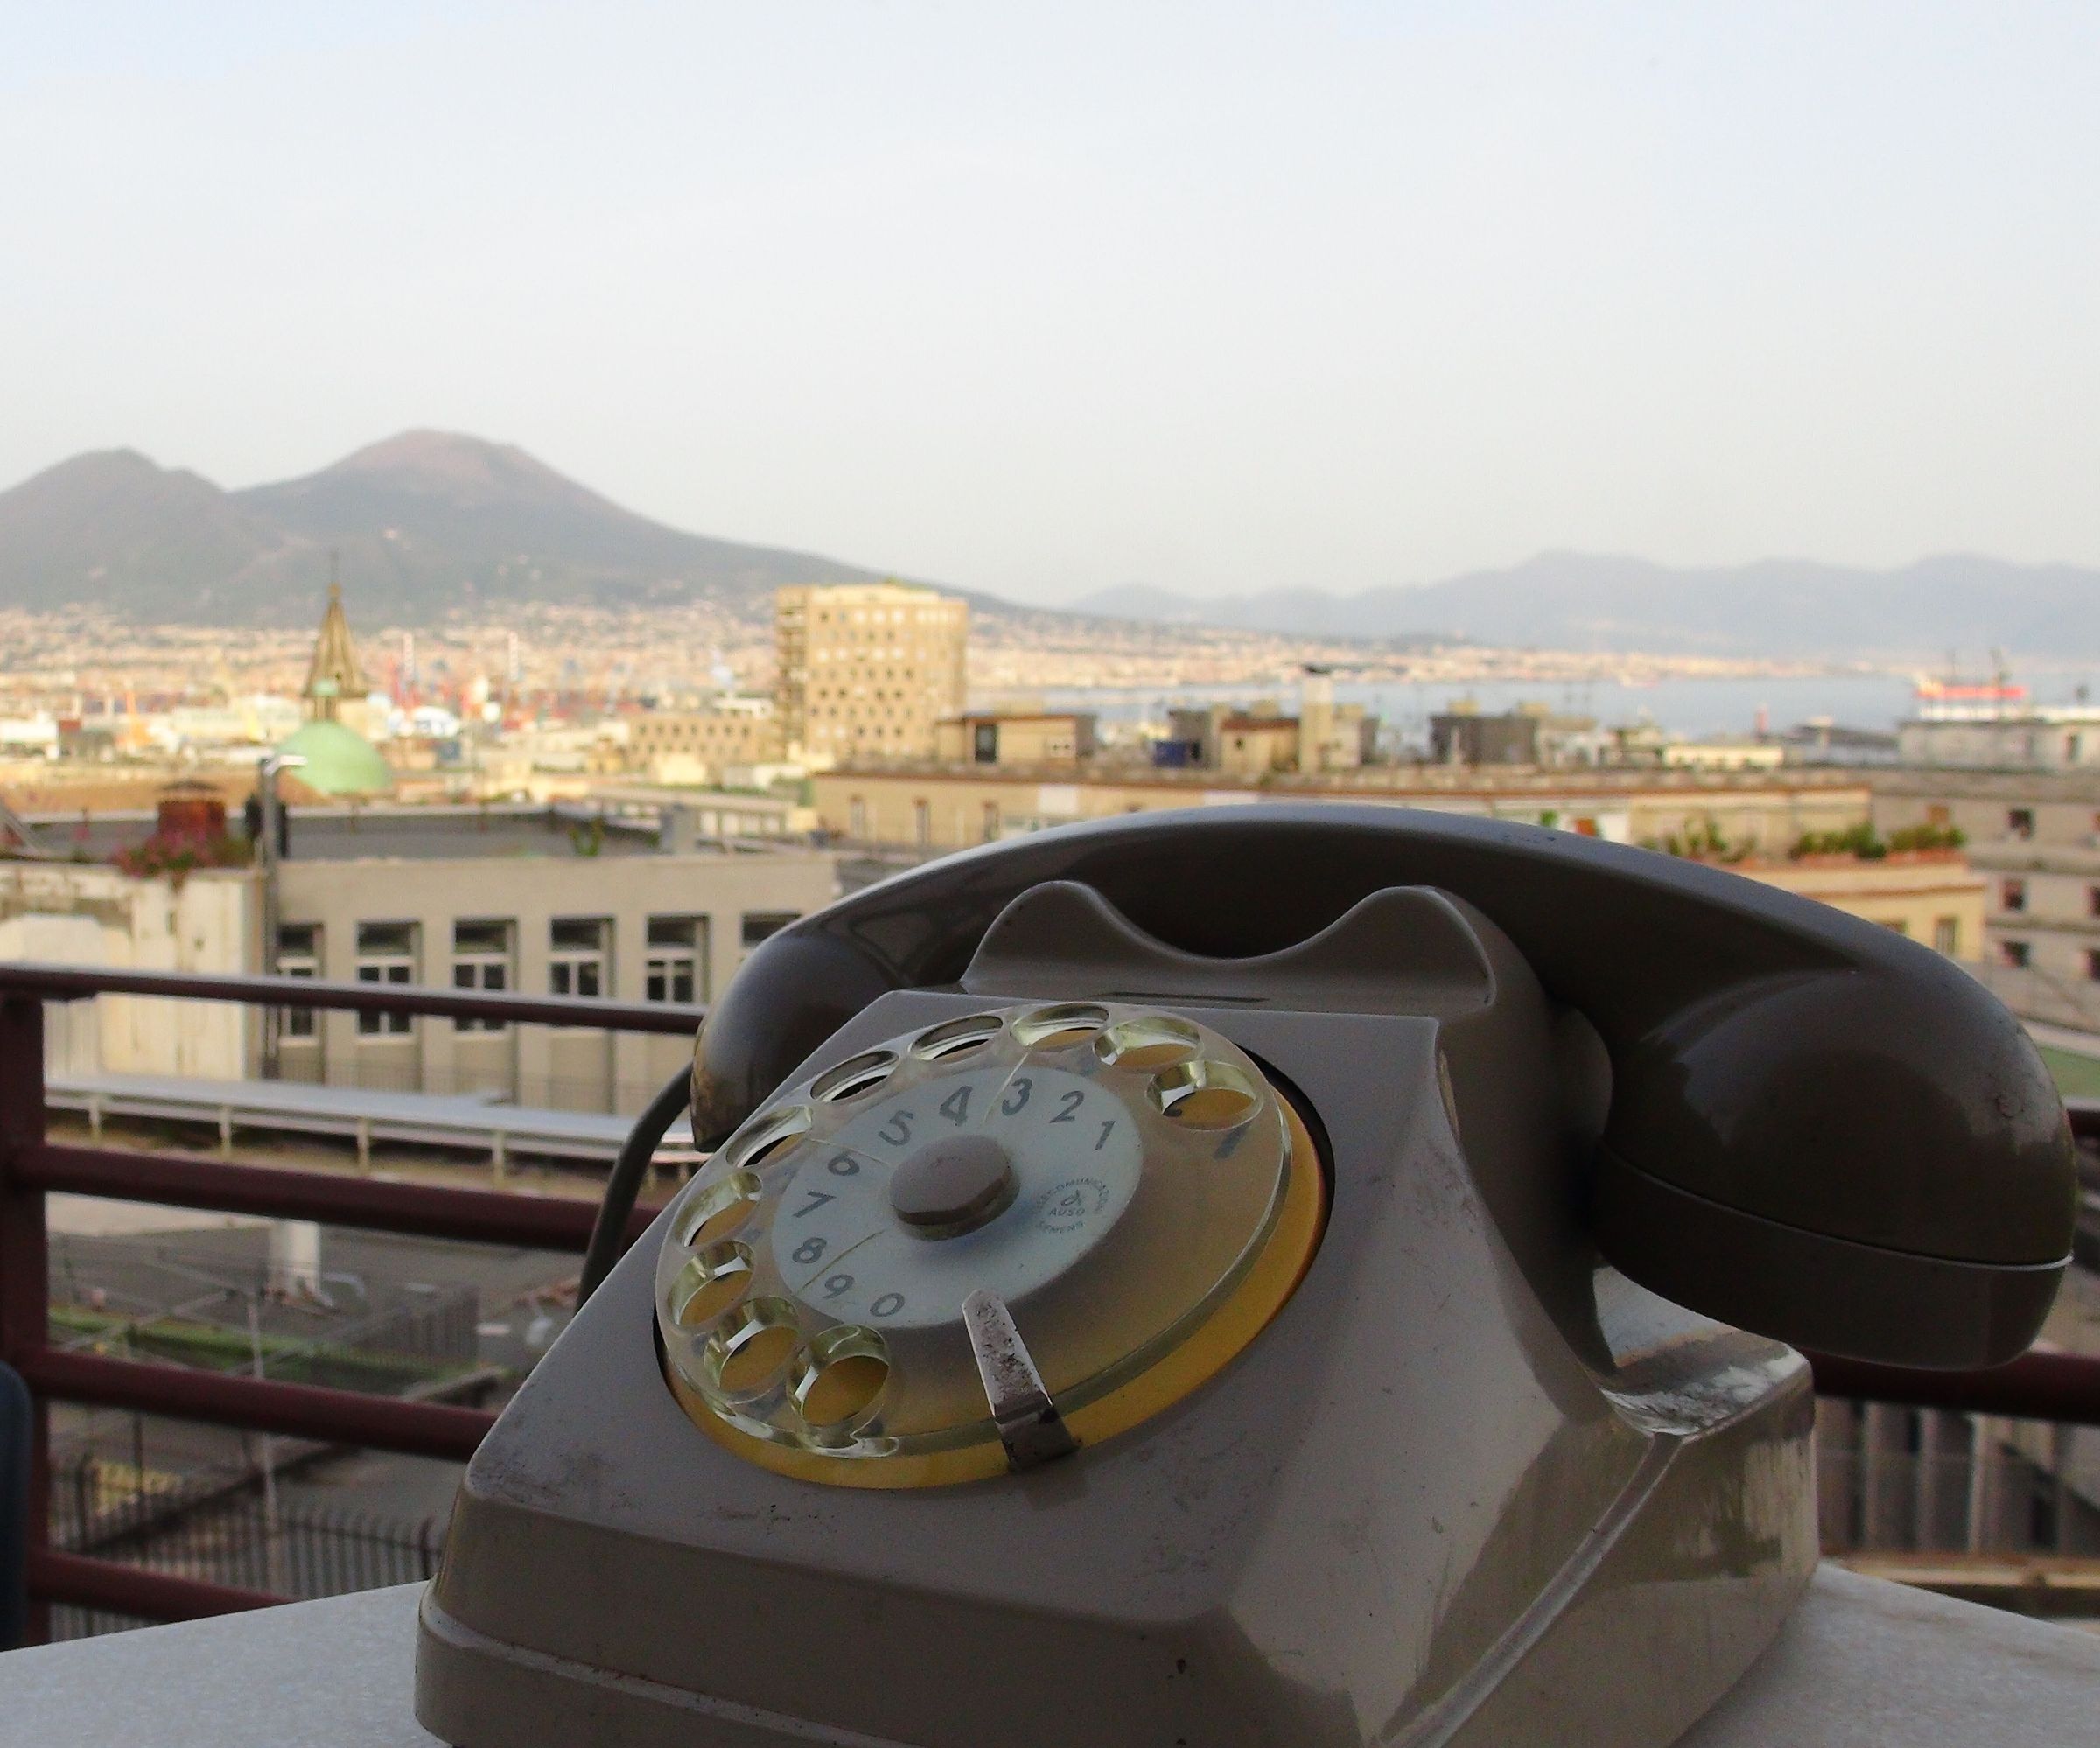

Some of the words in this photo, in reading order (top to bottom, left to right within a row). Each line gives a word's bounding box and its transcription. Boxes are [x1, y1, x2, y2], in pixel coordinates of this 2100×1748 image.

[939, 1086, 973, 1126] 4
[1002, 1078, 1033, 1116] 3
[1049, 1090, 1085, 1123] 2
[878, 1109, 914, 1147] 5
[1093, 1120, 1116, 1151] 1
[827, 1150, 861, 1177] 6
[792, 1190, 836, 1219] 7
[791, 1236, 828, 1265] 8
[822, 1274, 855, 1299] 9
[869, 1292, 906, 1318] 0
